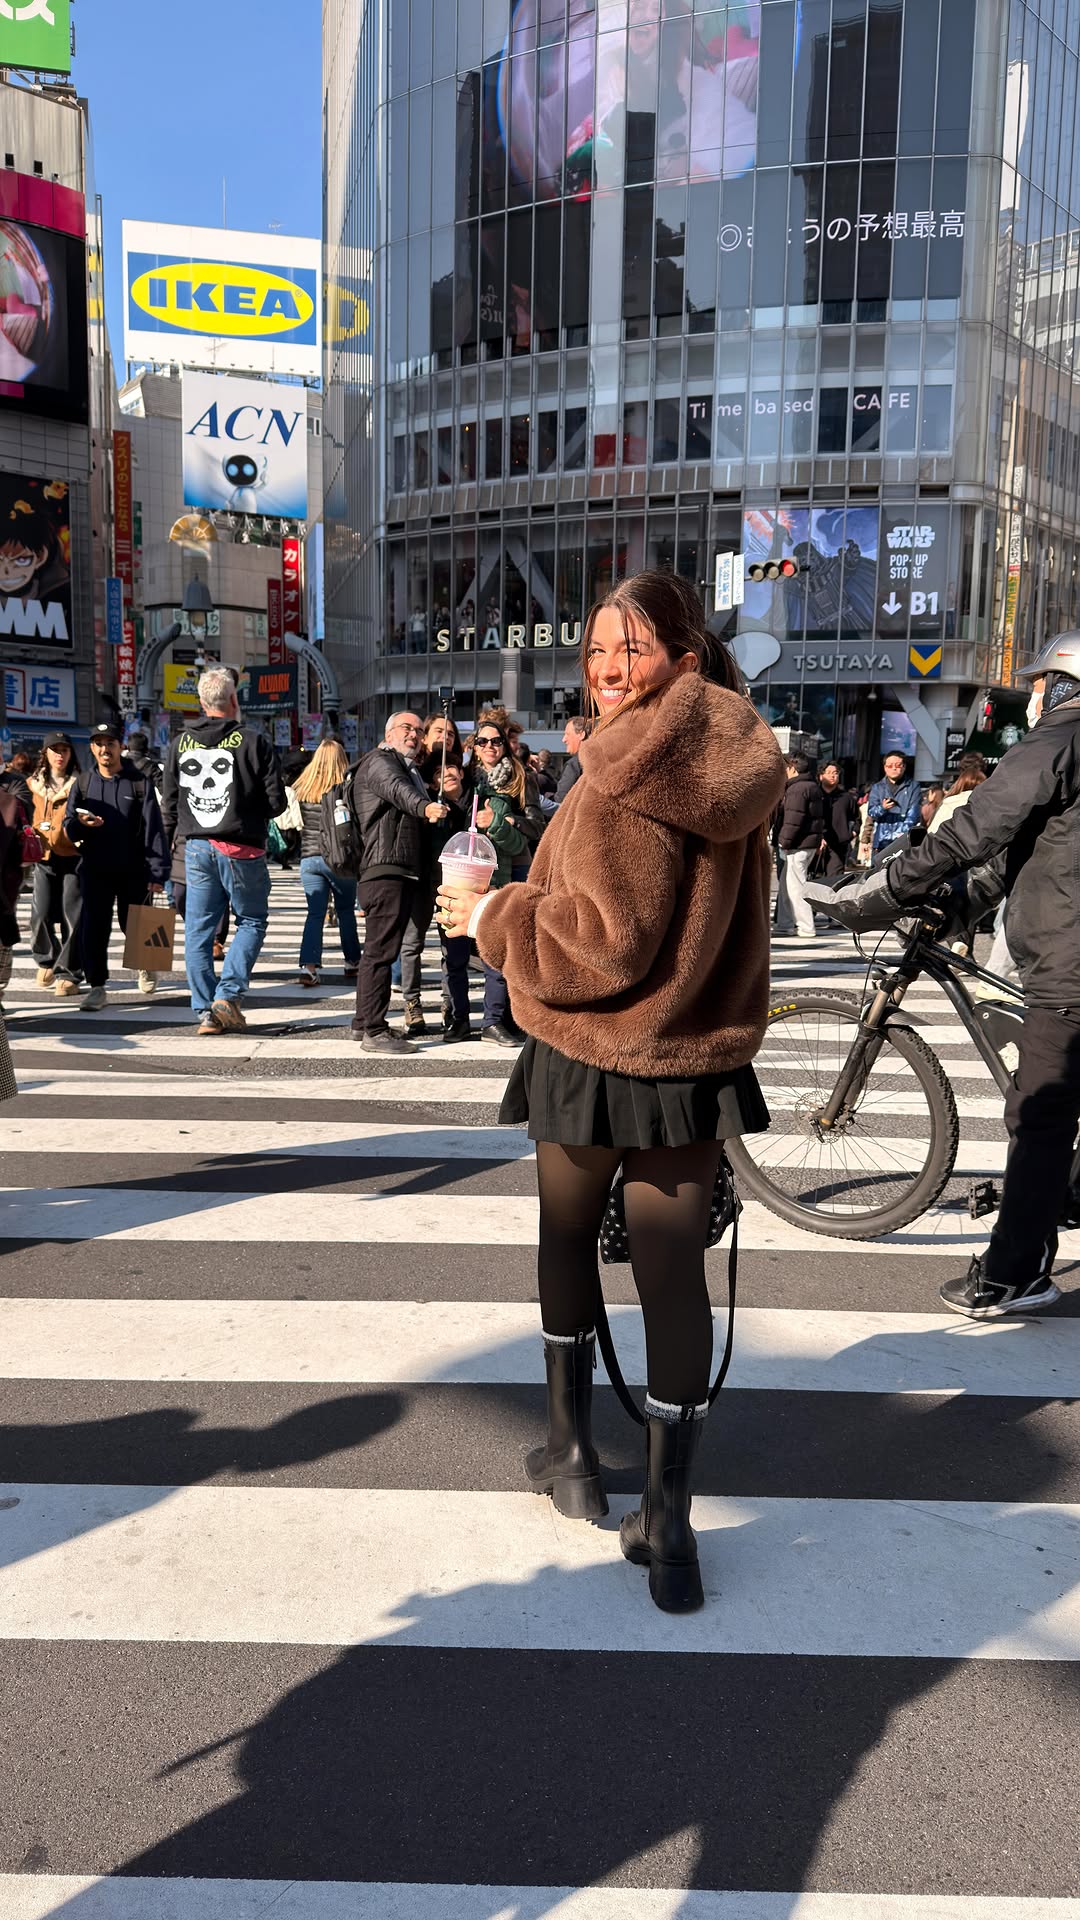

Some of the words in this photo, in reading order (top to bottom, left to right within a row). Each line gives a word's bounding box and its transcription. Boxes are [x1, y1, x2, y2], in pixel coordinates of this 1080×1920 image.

[148, 277, 302, 321] IKEA
[689, 402, 742, 420] Time
[754, 396, 814, 415] based
[853, 392, 911, 411] CAFE
[186, 401, 304, 447] ACN
[117, 435, 129, 533] クスリのことなら
[886, 525, 935, 537] STAR
[886, 537, 935, 548] WARS
[283, 548, 298, 623] カラオケ
[910, 591, 939, 616] B1
[270, 636, 281, 663] カラ
[437, 621, 580, 652] STARBU
[793, 653, 893, 671] TSUTAYA
